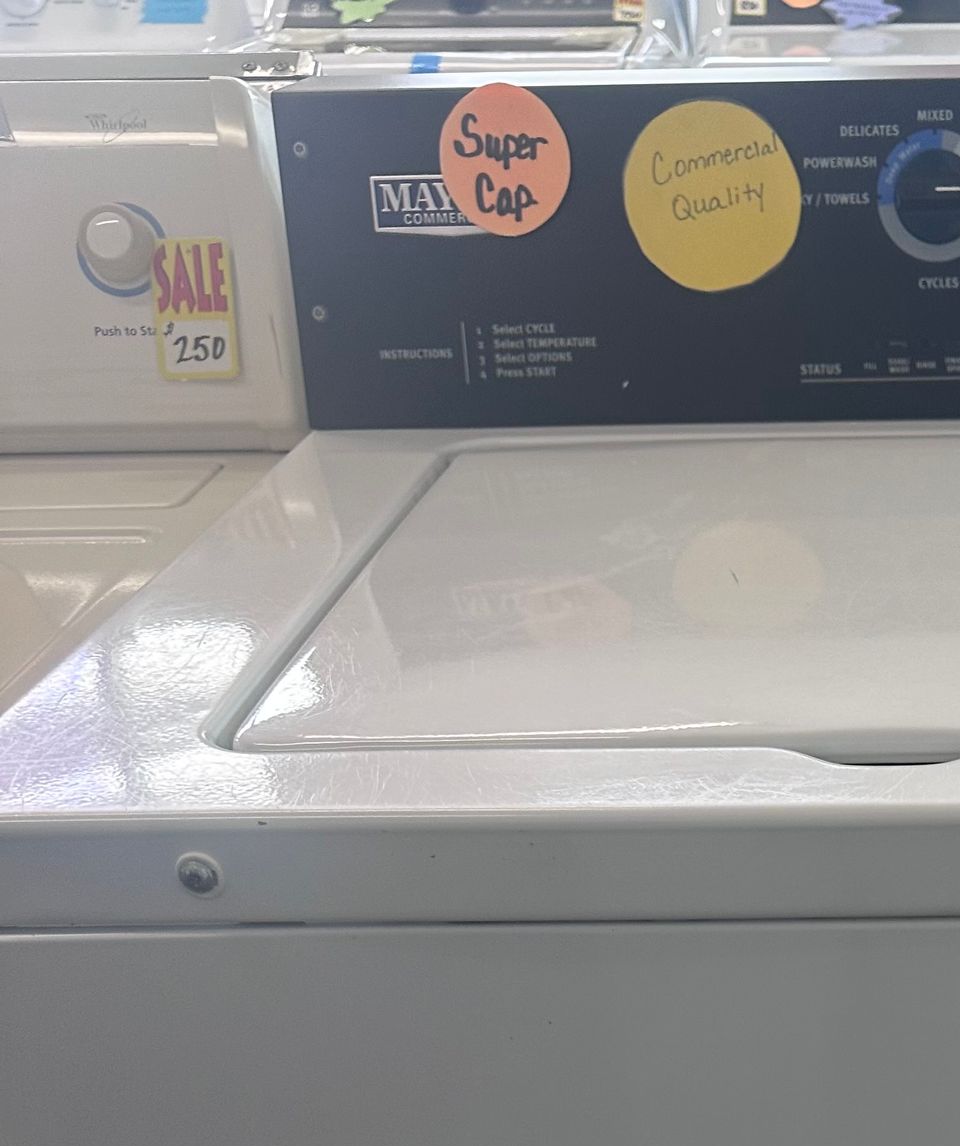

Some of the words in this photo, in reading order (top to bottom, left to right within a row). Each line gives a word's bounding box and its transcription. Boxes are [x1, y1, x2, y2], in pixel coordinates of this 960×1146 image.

[917, 110, 953, 121] MIXED
[840, 125, 900, 137] DELICATES
[453, 112, 549, 170] Super
[651, 132, 779, 186] Commercial
[803, 156, 877, 168] POWERWASH
[475, 172, 538, 222] Cap
[672, 182, 764, 221] Quality
[815, 192, 822, 207] /
[824, 192, 870, 205] TOWELS
[153, 243, 228, 314] SALE
[918, 277, 960, 289] CYCLES
[94, 326, 121, 337] Push
[125, 326, 137, 337] to
[491, 324, 523, 335] Select
[525, 322, 556, 334] CYCLE
[493, 338, 525, 349] Select
[526, 336, 598, 348] TEMPERATURE
[379, 348, 453, 360] INSTRUCTIONS
[494, 353, 526, 364] Select
[527, 351, 573, 363] OPTIONS
[496, 368, 524, 379] Press
[525, 366, 557, 378] START
[800, 363, 842, 375] STATUS
